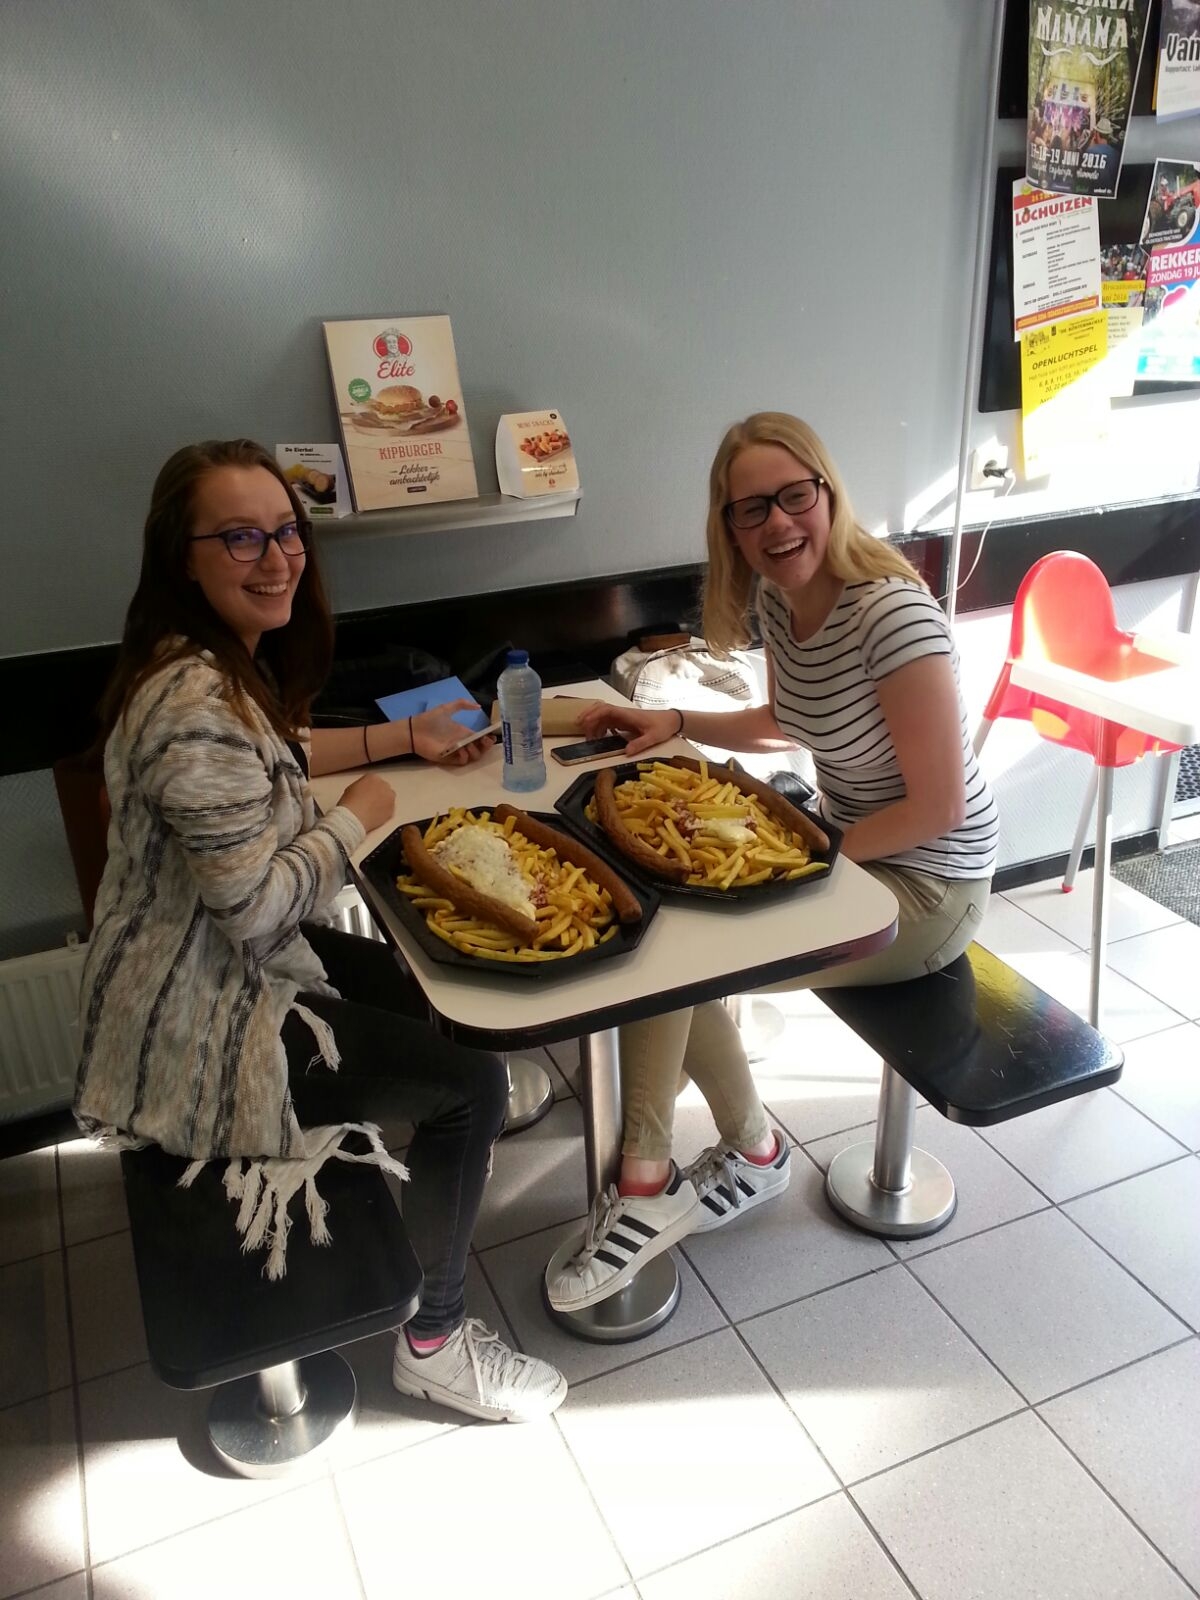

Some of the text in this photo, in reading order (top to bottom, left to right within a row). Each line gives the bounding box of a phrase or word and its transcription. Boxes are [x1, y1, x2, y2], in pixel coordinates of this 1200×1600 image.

[1062, 150, 1080, 167] JUNI
[1082, 152, 1107, 169] 2016
[1015, 197, 1093, 226] LOCHUIZEN
[1151, 269, 1182, 284] ZONDAG
[1184, 267, 1193, 278] 19
[1032, 344, 1098, 370] OPENLUCHTSPEL
[377, 359, 415, 379] Elite
[379, 442, 443, 460] KIPBURGER
[399, 463, 428, 475] Lekker
[389, 471, 440, 486] ambachtelijk
